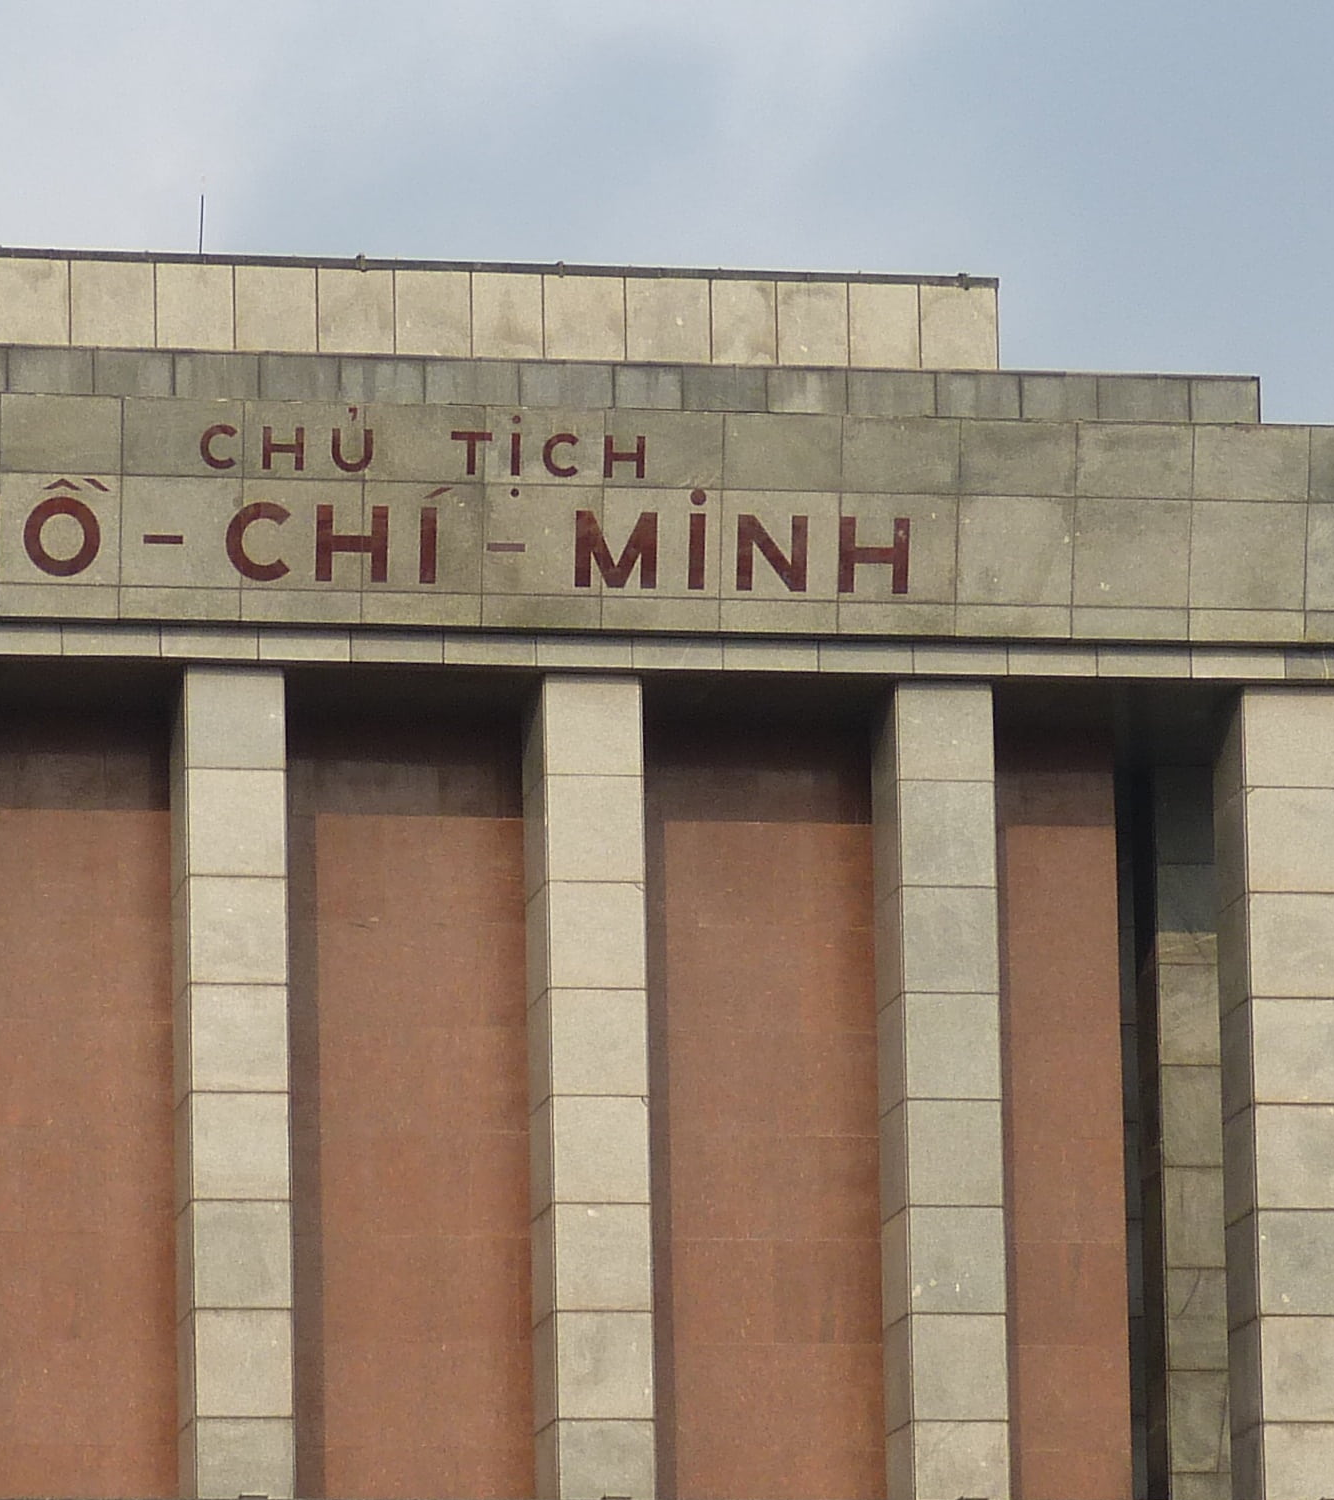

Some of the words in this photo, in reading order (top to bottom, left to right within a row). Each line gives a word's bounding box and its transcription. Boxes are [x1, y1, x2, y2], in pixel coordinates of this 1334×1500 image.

[199, 406, 375, 473] CHỦ
[450, 414, 647, 499] TỊCH
[225, 486, 454, 585] CHÍ
